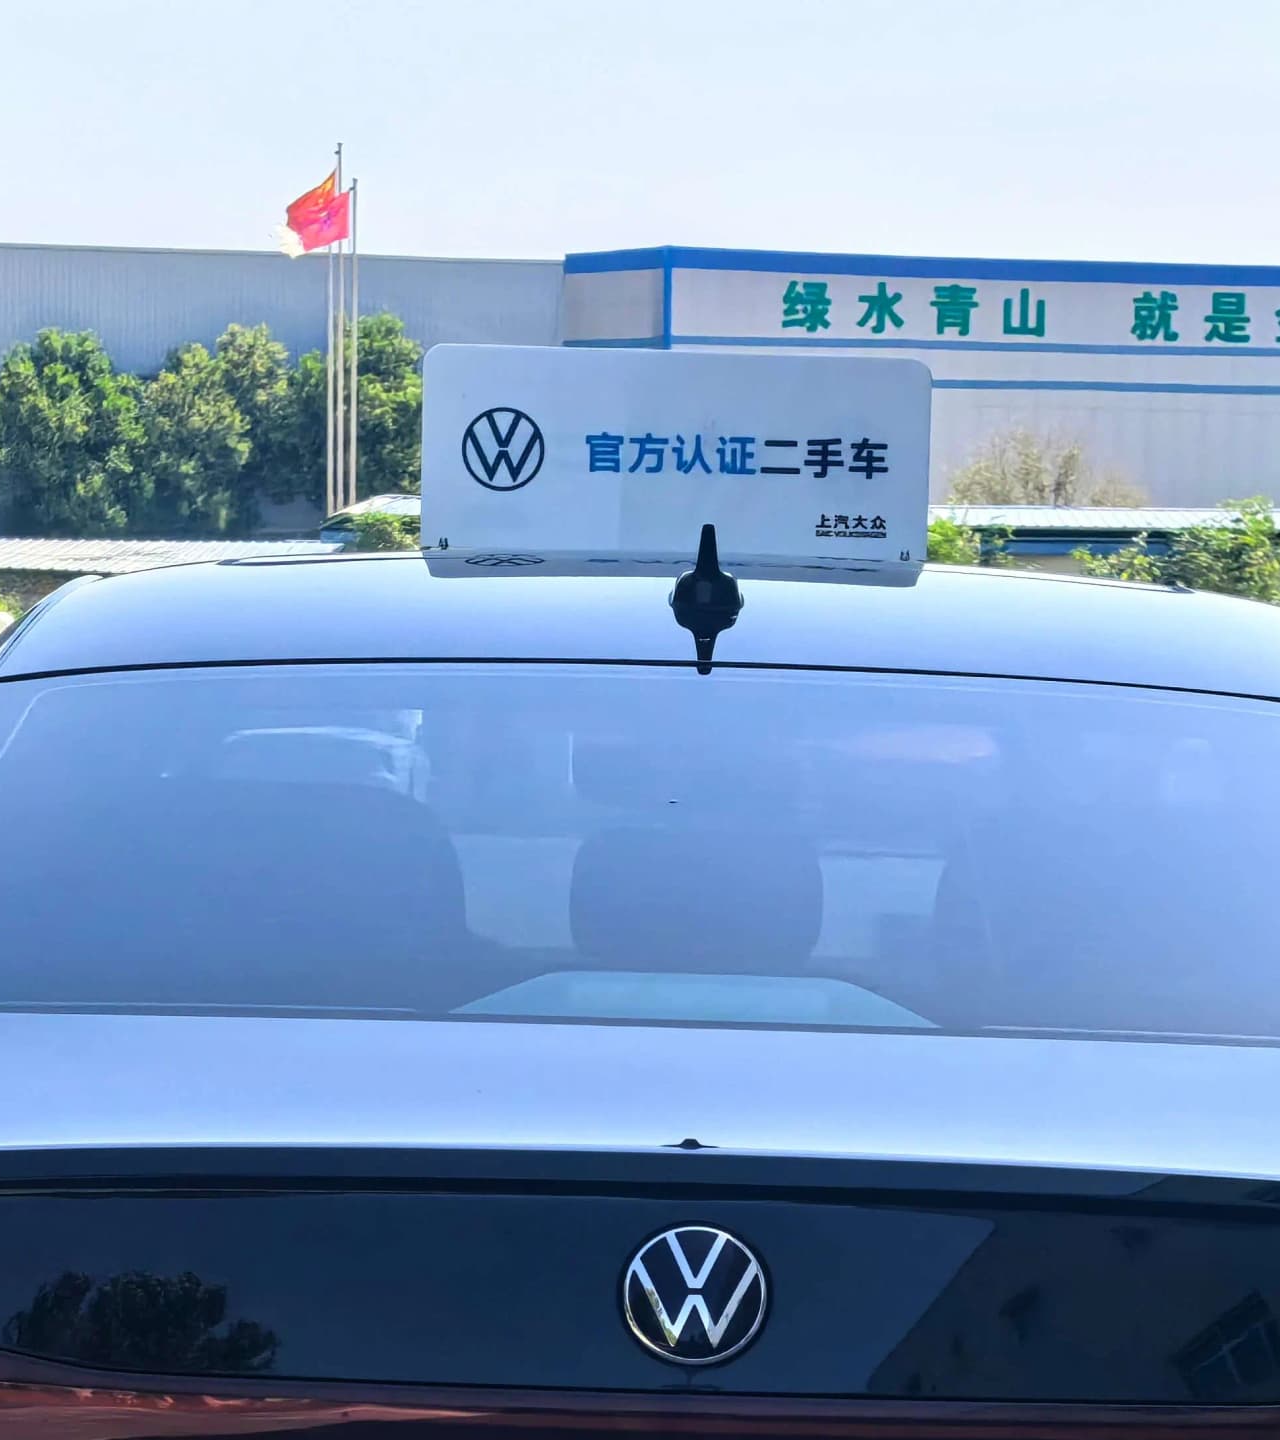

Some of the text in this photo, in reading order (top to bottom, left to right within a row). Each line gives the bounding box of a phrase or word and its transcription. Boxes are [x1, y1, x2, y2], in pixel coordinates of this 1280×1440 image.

[781, 281, 1048, 339] 绿水青山
[585, 431, 890, 480] 官方认证二手车
[815, 513, 887, 530] 上汽大众
